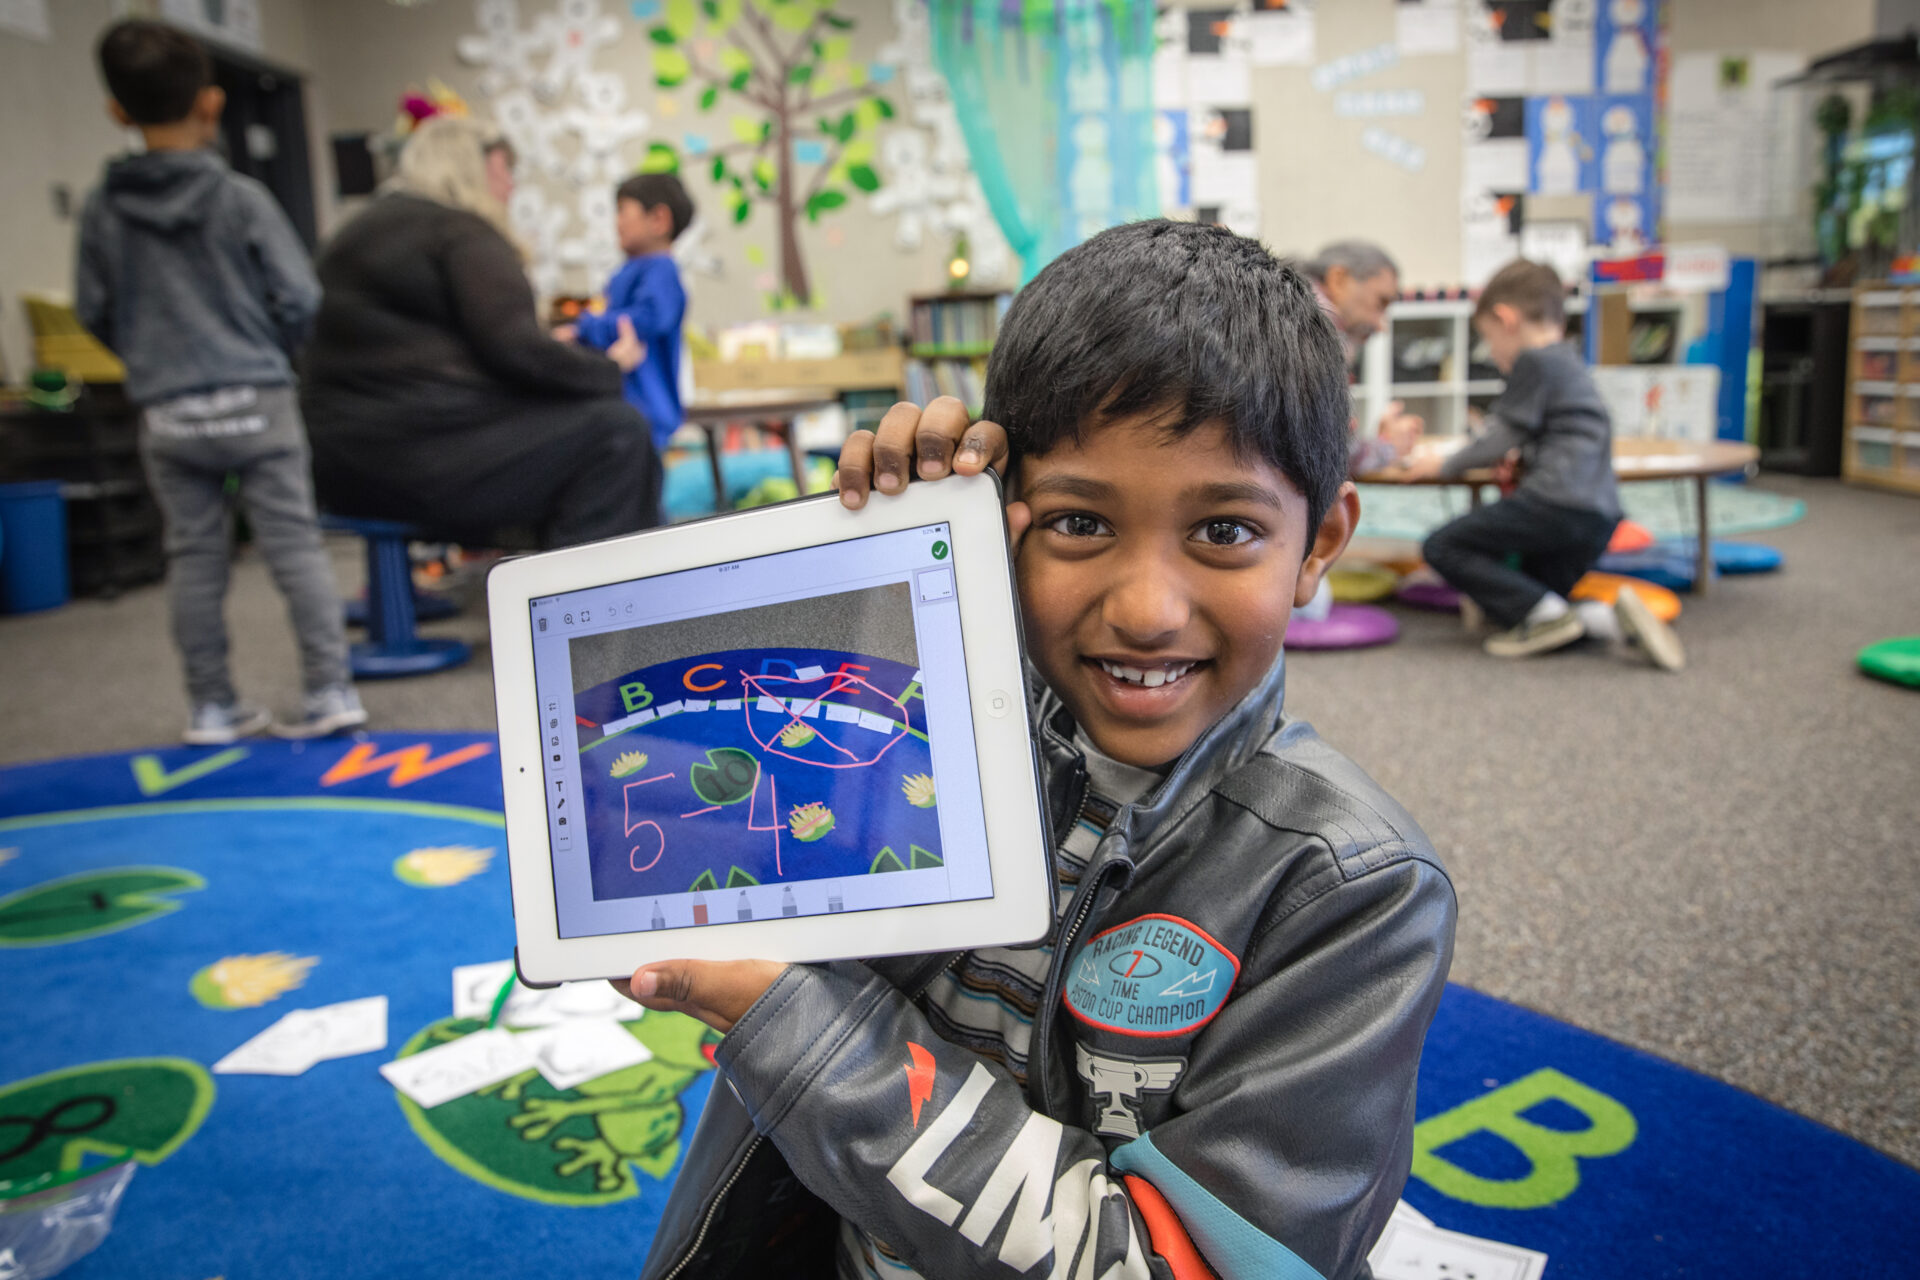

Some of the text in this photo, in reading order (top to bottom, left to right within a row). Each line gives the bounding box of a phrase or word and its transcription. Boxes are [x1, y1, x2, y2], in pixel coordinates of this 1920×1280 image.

[619, 681, 654, 713] B
[683, 663, 727, 692] C
[759, 658, 797, 686] D
[831, 662, 871, 695] E
[320, 743, 493, 789] W
[704, 759, 753, 803] 10
[624, 772, 675, 872] 5
[747, 761, 787, 876] 4
[1093, 925, 1205, 967] RACING LEGEND
[1124, 950, 1144, 978] 7
[1098, 997, 1123, 1020] CUP
[1127, 999, 1205, 1025] CHAMPION
[1110, 979, 1141, 1000] TIME
[1410, 1066, 1638, 1210] B
